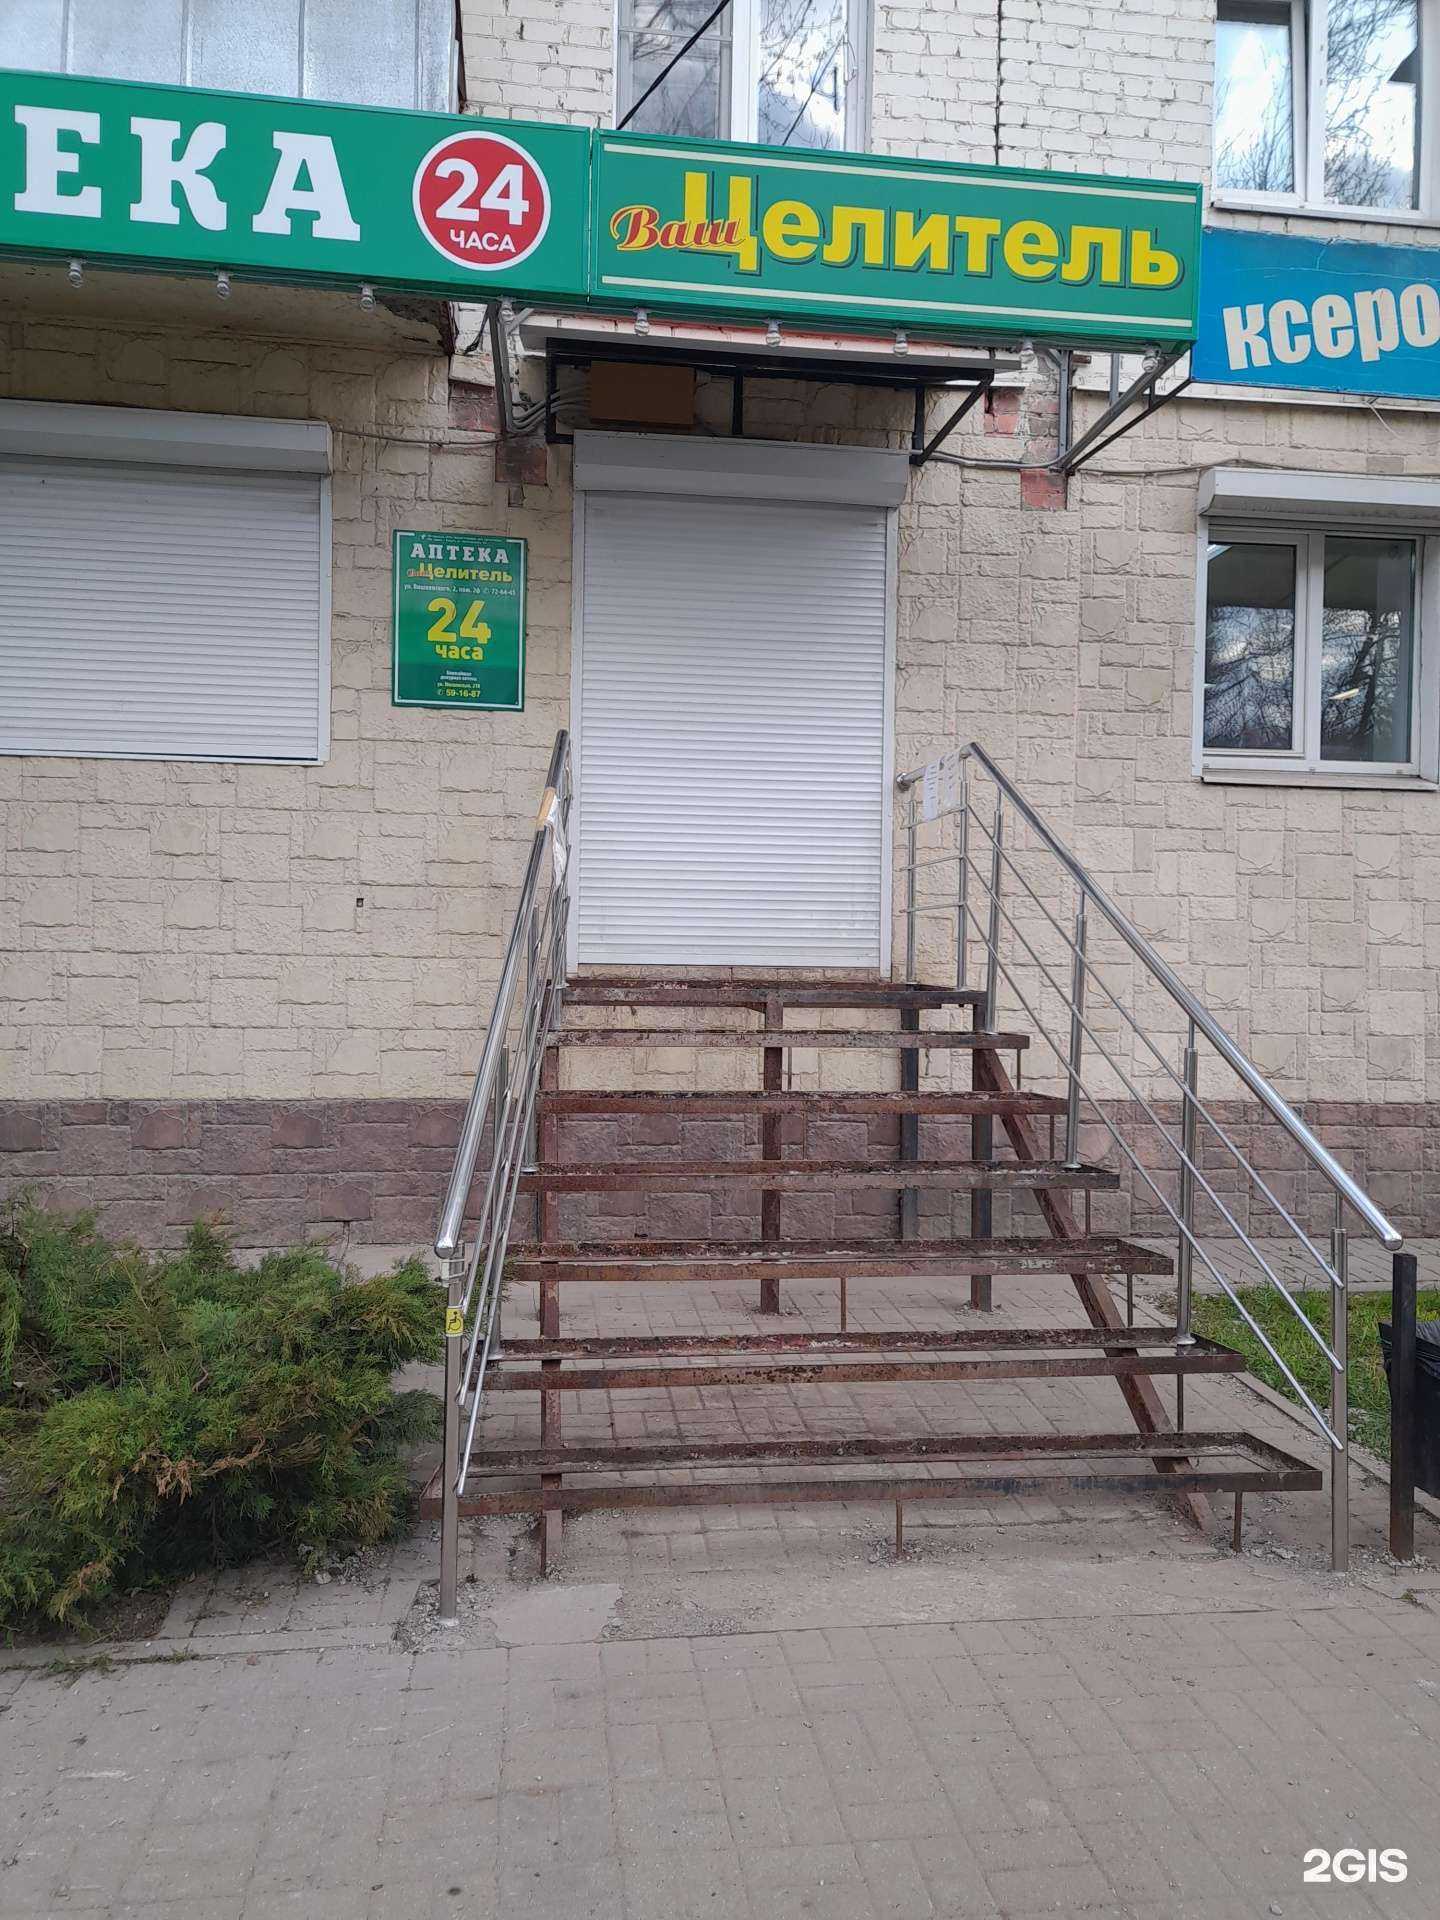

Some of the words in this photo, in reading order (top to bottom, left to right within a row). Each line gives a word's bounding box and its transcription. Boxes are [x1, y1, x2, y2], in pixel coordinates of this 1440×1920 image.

[13, 103, 361, 242] ЕКА
[434, 157, 530, 226] 24
[448, 228, 516, 253] ЧАСА
[609, 204, 746, 252] Ваш
[682, 170, 1184, 290] Целитель
[1222, 283, 1440, 371] ксеро
[410, 543, 509, 564] АПТЕКА
[419, 562, 513, 583] Целитель
[427, 597, 492, 644] 24
[435, 644, 484, 660] часа
